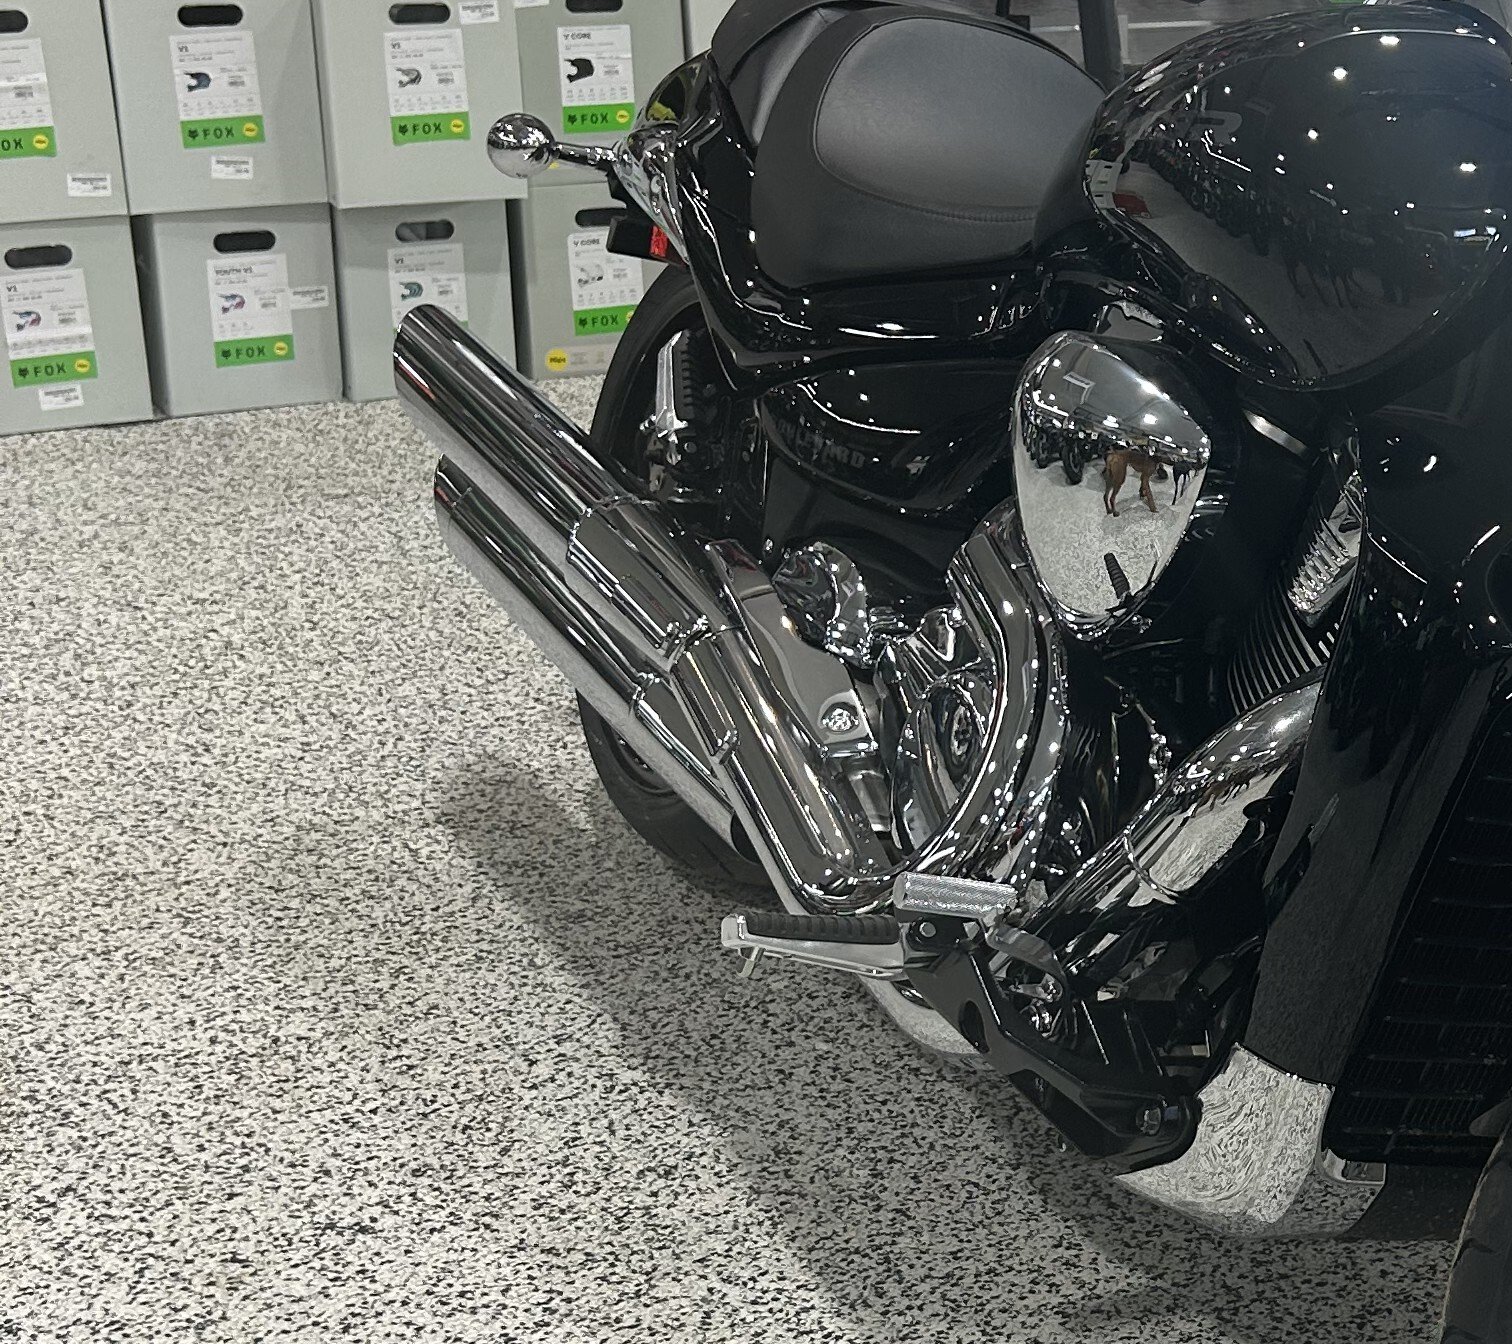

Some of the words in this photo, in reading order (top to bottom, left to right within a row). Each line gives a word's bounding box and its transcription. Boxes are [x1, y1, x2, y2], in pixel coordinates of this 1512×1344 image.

[578, 111, 609, 124] FOX
[202, 126, 235, 140] FOX
[412, 118, 442, 134] FOX
[0, 137, 24, 151] OX
[591, 315, 619, 327] FOX
[235, 345, 266, 358] FOX
[34, 361, 67, 377] FOX
